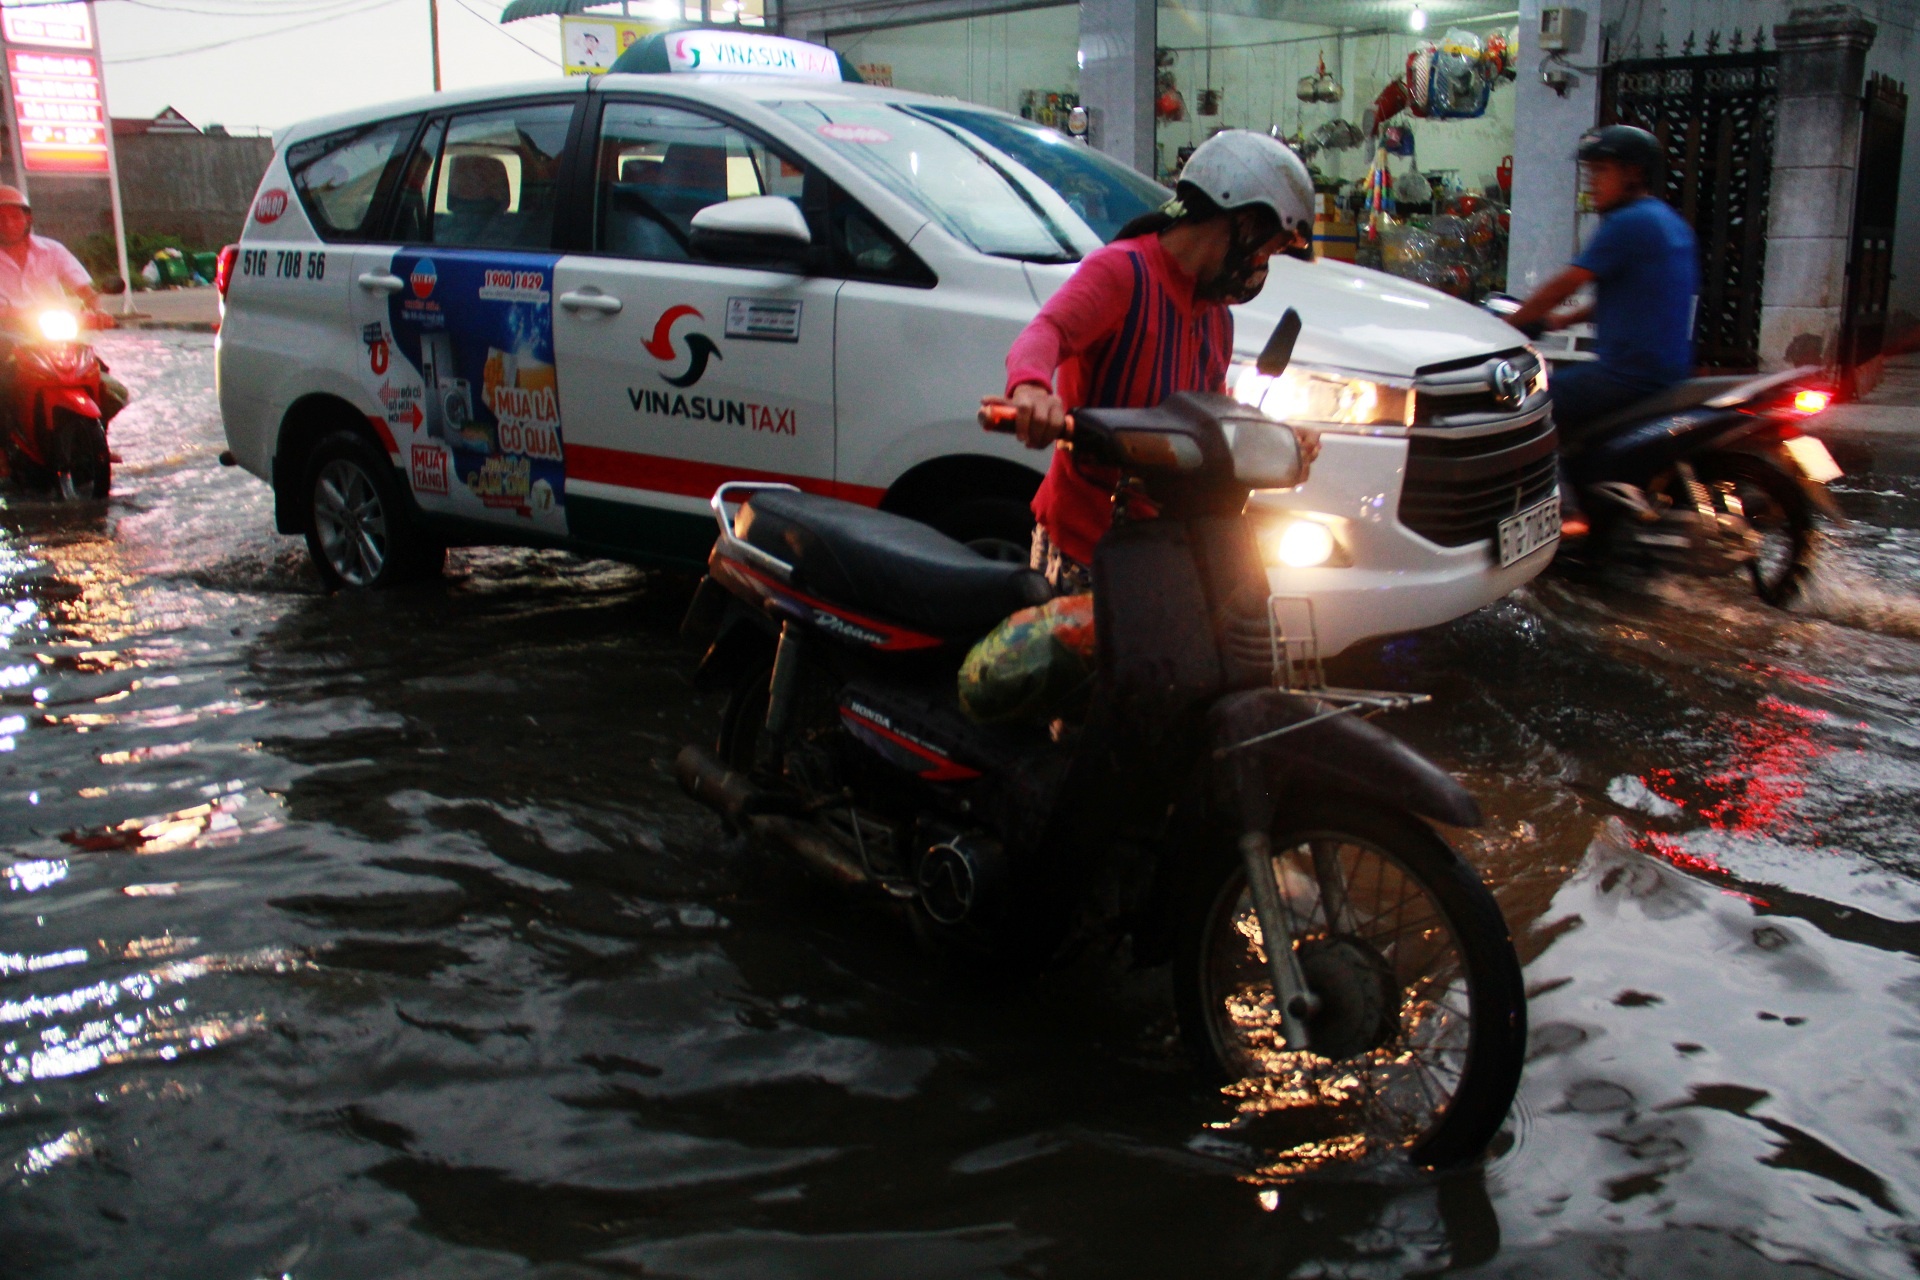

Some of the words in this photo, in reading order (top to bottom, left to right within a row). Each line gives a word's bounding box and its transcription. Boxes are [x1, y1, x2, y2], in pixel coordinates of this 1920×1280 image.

[710, 42, 797, 69] VINASUN
[243, 250, 267, 277] 51G
[276, 251, 302, 278] 708
[307, 252, 326, 280] 56
[486, 271, 513, 288] 1900
[515, 273, 543, 290] 1829
[497, 390, 533, 419] MUA
[415, 451, 440, 470] MUA
[851, 701, 890, 729] HONDA
